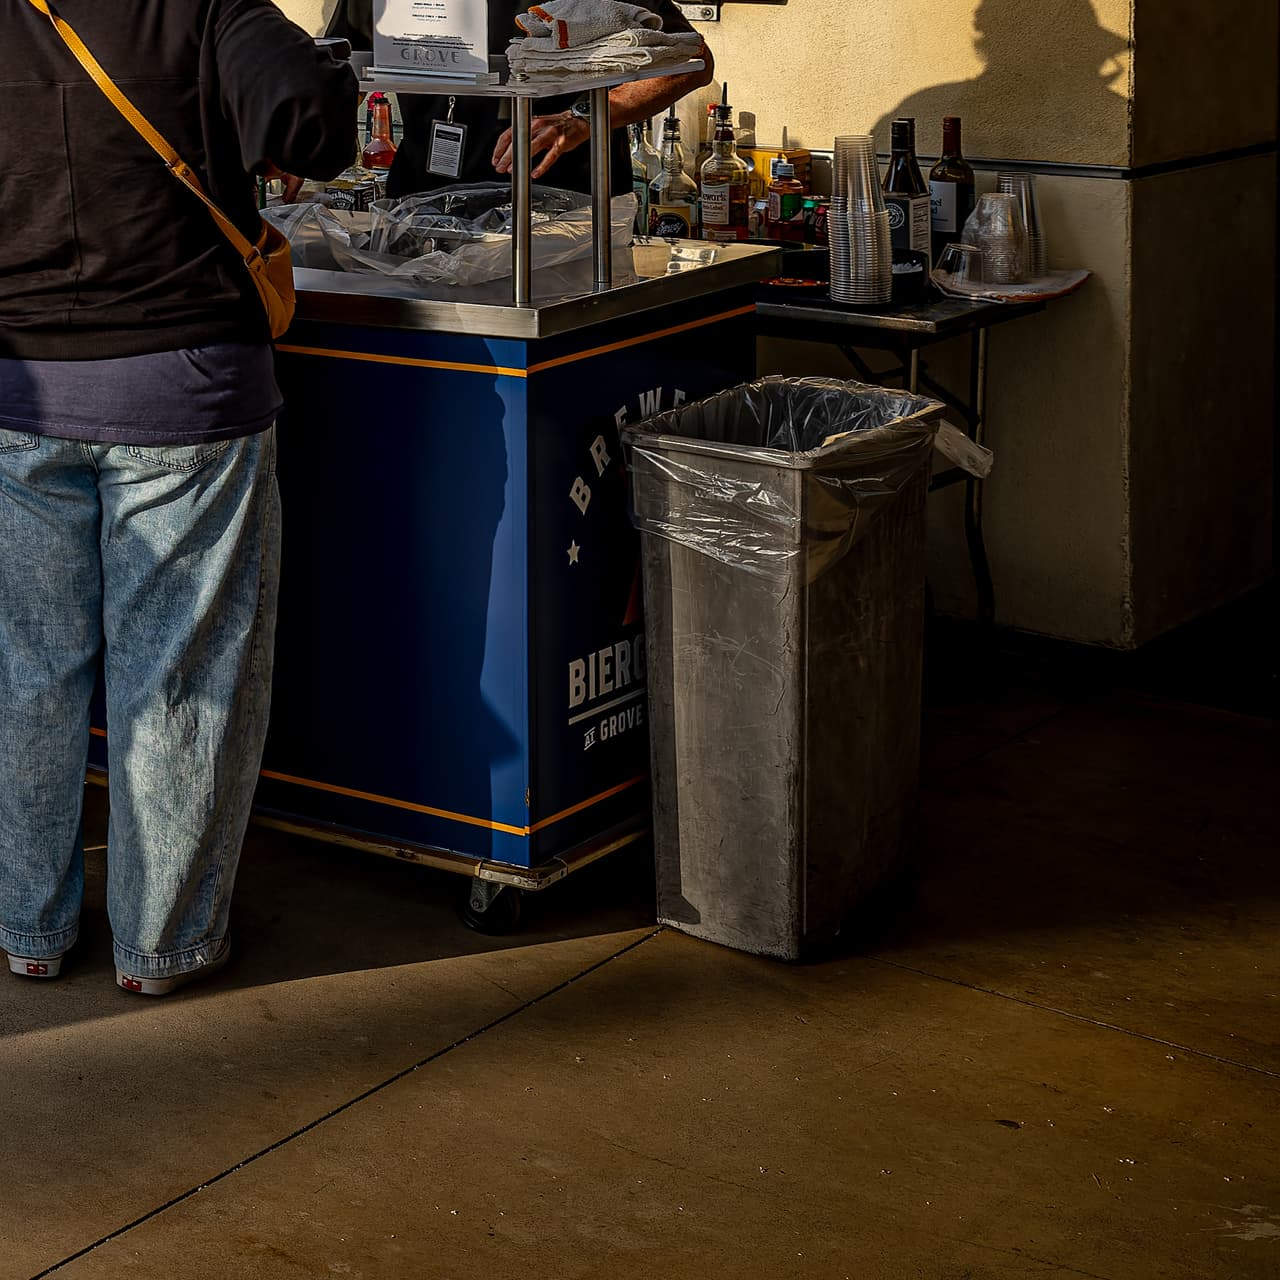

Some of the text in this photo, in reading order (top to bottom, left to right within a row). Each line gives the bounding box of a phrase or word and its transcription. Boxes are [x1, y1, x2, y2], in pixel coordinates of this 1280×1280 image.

[400, 47, 460, 64] GROVE
[568, 633, 646, 709] BIERG
[584, 704, 643, 748] AT GROVE
